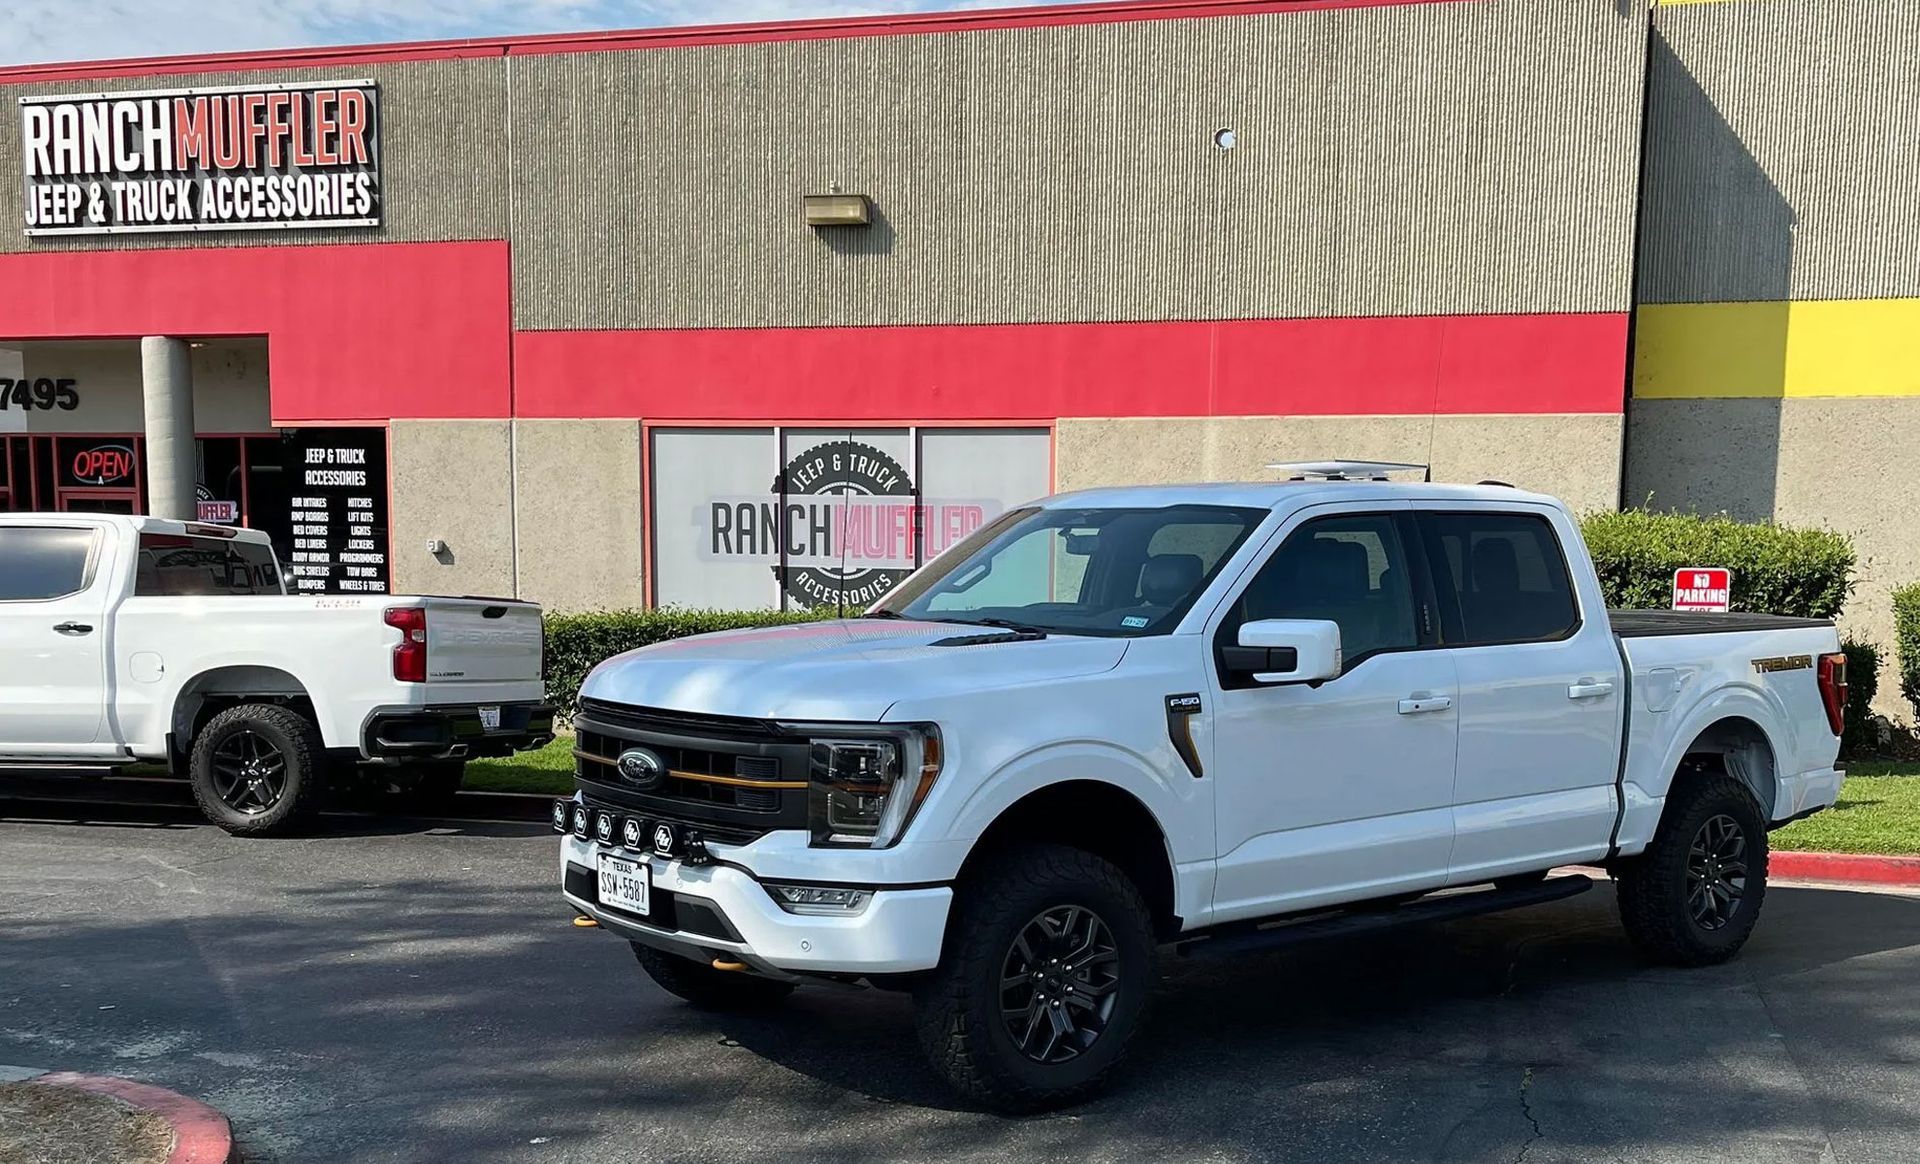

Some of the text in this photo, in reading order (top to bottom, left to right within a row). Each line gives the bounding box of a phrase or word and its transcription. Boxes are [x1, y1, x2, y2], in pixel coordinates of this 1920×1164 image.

[25, 172, 371, 226] JEEP & TRUCK ACCESSORIES
[0, 378, 79, 411] 7495
[305, 448, 365, 464] JEEP & TRUCK
[73, 451, 130, 477] OPEN
[305, 470, 366, 486] ACCESSORIES
[792, 453, 900, 492] JEEP & TRUCK
[348, 497, 372, 508] HITCHES
[348, 512, 359, 522] LIFT
[305, 525, 328, 535] COVERS
[351, 526, 371, 536] LIGHTS
[348, 539, 374, 550] LOCKERS
[340, 552, 384, 563] PROGRAMMERS
[305, 566, 330, 576] SHIELDS
[347, 566, 360, 577] TOW
[298, 579, 326, 590] BUMPERS
[339, 579, 362, 590] WHEELS
[1694, 573, 1710, 588] NO
[796, 572, 892, 605] ACCESSORIES
[1677, 588, 1727, 603] PARKING
[1751, 655, 1813, 674] TREMOR
[1170, 697, 1200, 707] F-150
[612, 861, 632, 874] TEXAS
